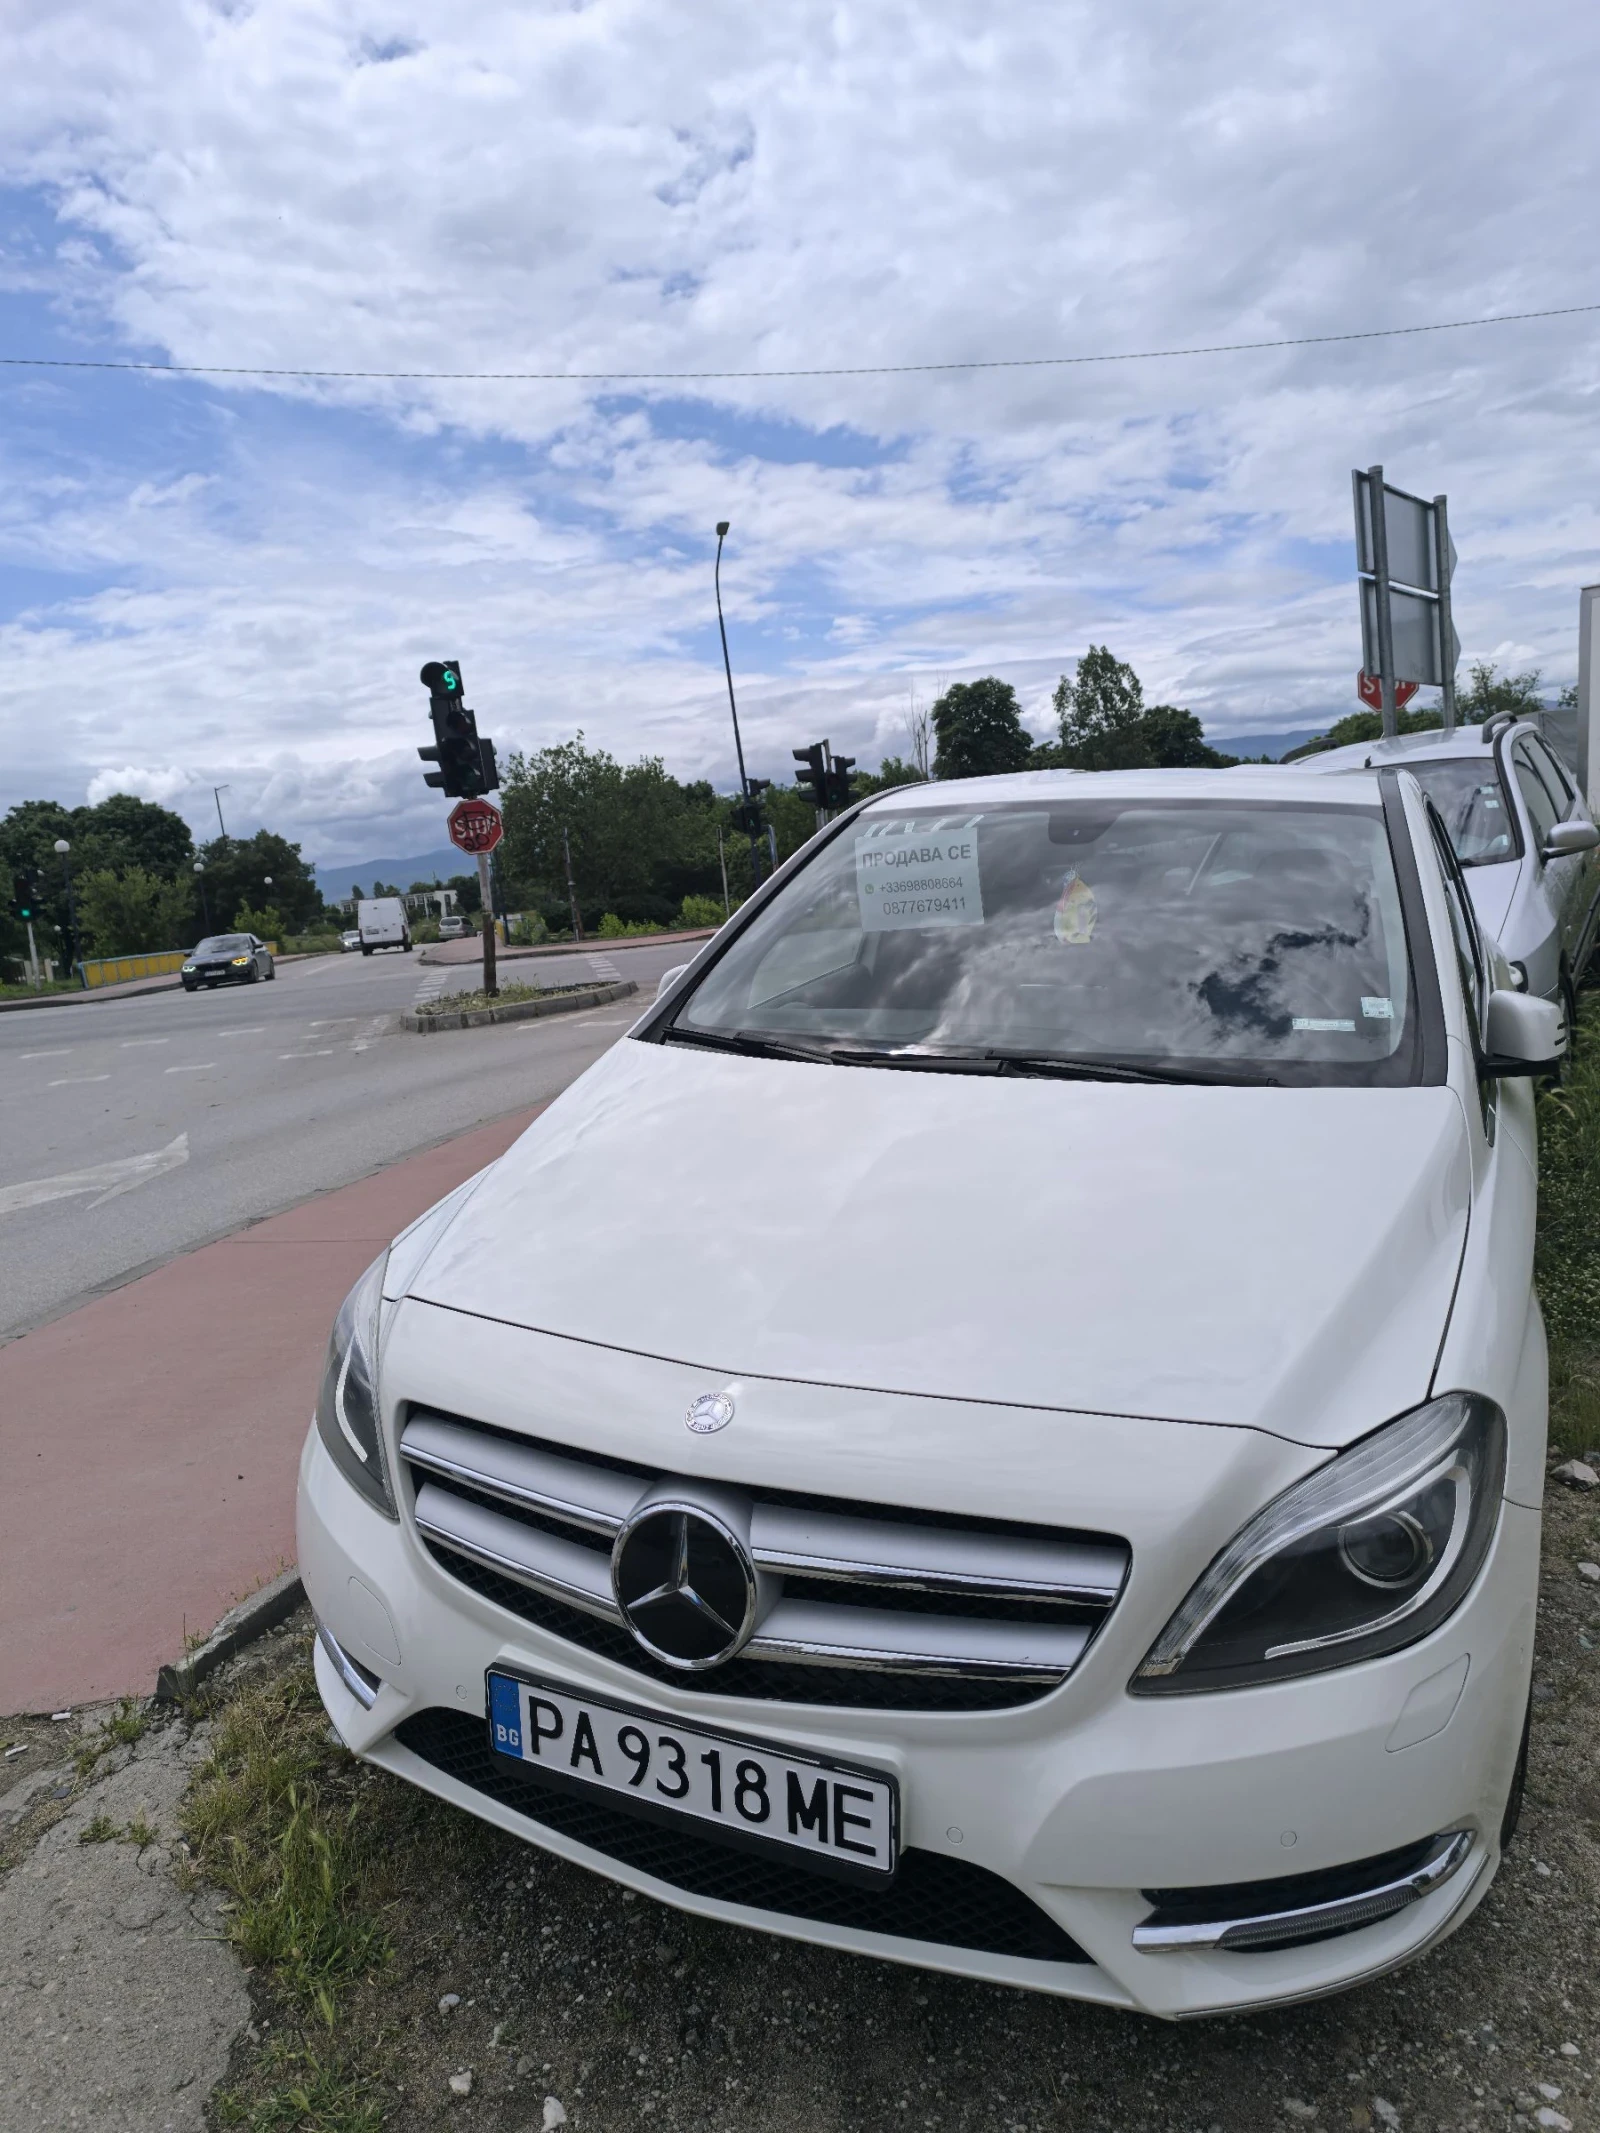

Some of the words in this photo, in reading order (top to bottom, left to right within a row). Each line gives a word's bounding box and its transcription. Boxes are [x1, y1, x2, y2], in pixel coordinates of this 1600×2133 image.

[454, 815, 497, 839] STOP
[862, 847, 942, 868] ПРОДАВА
[948, 844, 971, 860] СЕ
[880, 876, 963, 893] +33698808664
[883, 897, 965, 915] 0877679411
[497, 1724, 519, 1747] BG
[529, 1696, 604, 1776] PA
[617, 1725, 770, 1823] 9318
[786, 1771, 876, 1857] ME
